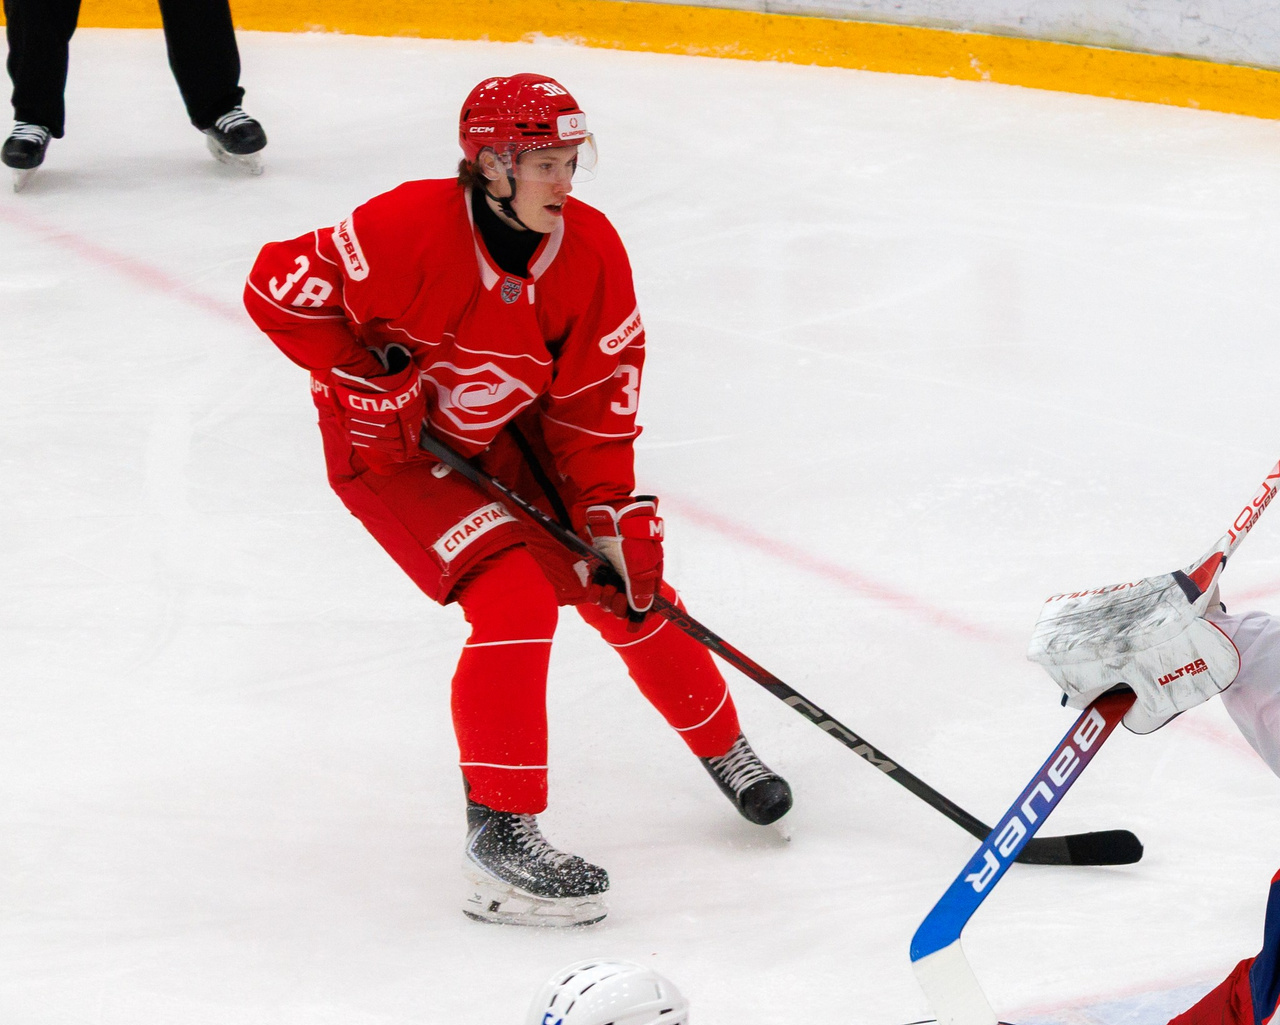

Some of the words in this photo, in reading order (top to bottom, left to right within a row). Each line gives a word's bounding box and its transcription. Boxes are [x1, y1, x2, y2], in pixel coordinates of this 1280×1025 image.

[531, 82, 567, 97] 38
[268, 255, 333, 308] 38
[1158, 657, 1206, 686] ULTRA
[1191, 664, 1209, 677] PRO
[782, 695, 898, 773] CCM
[965, 706, 1106, 893] BAUER
